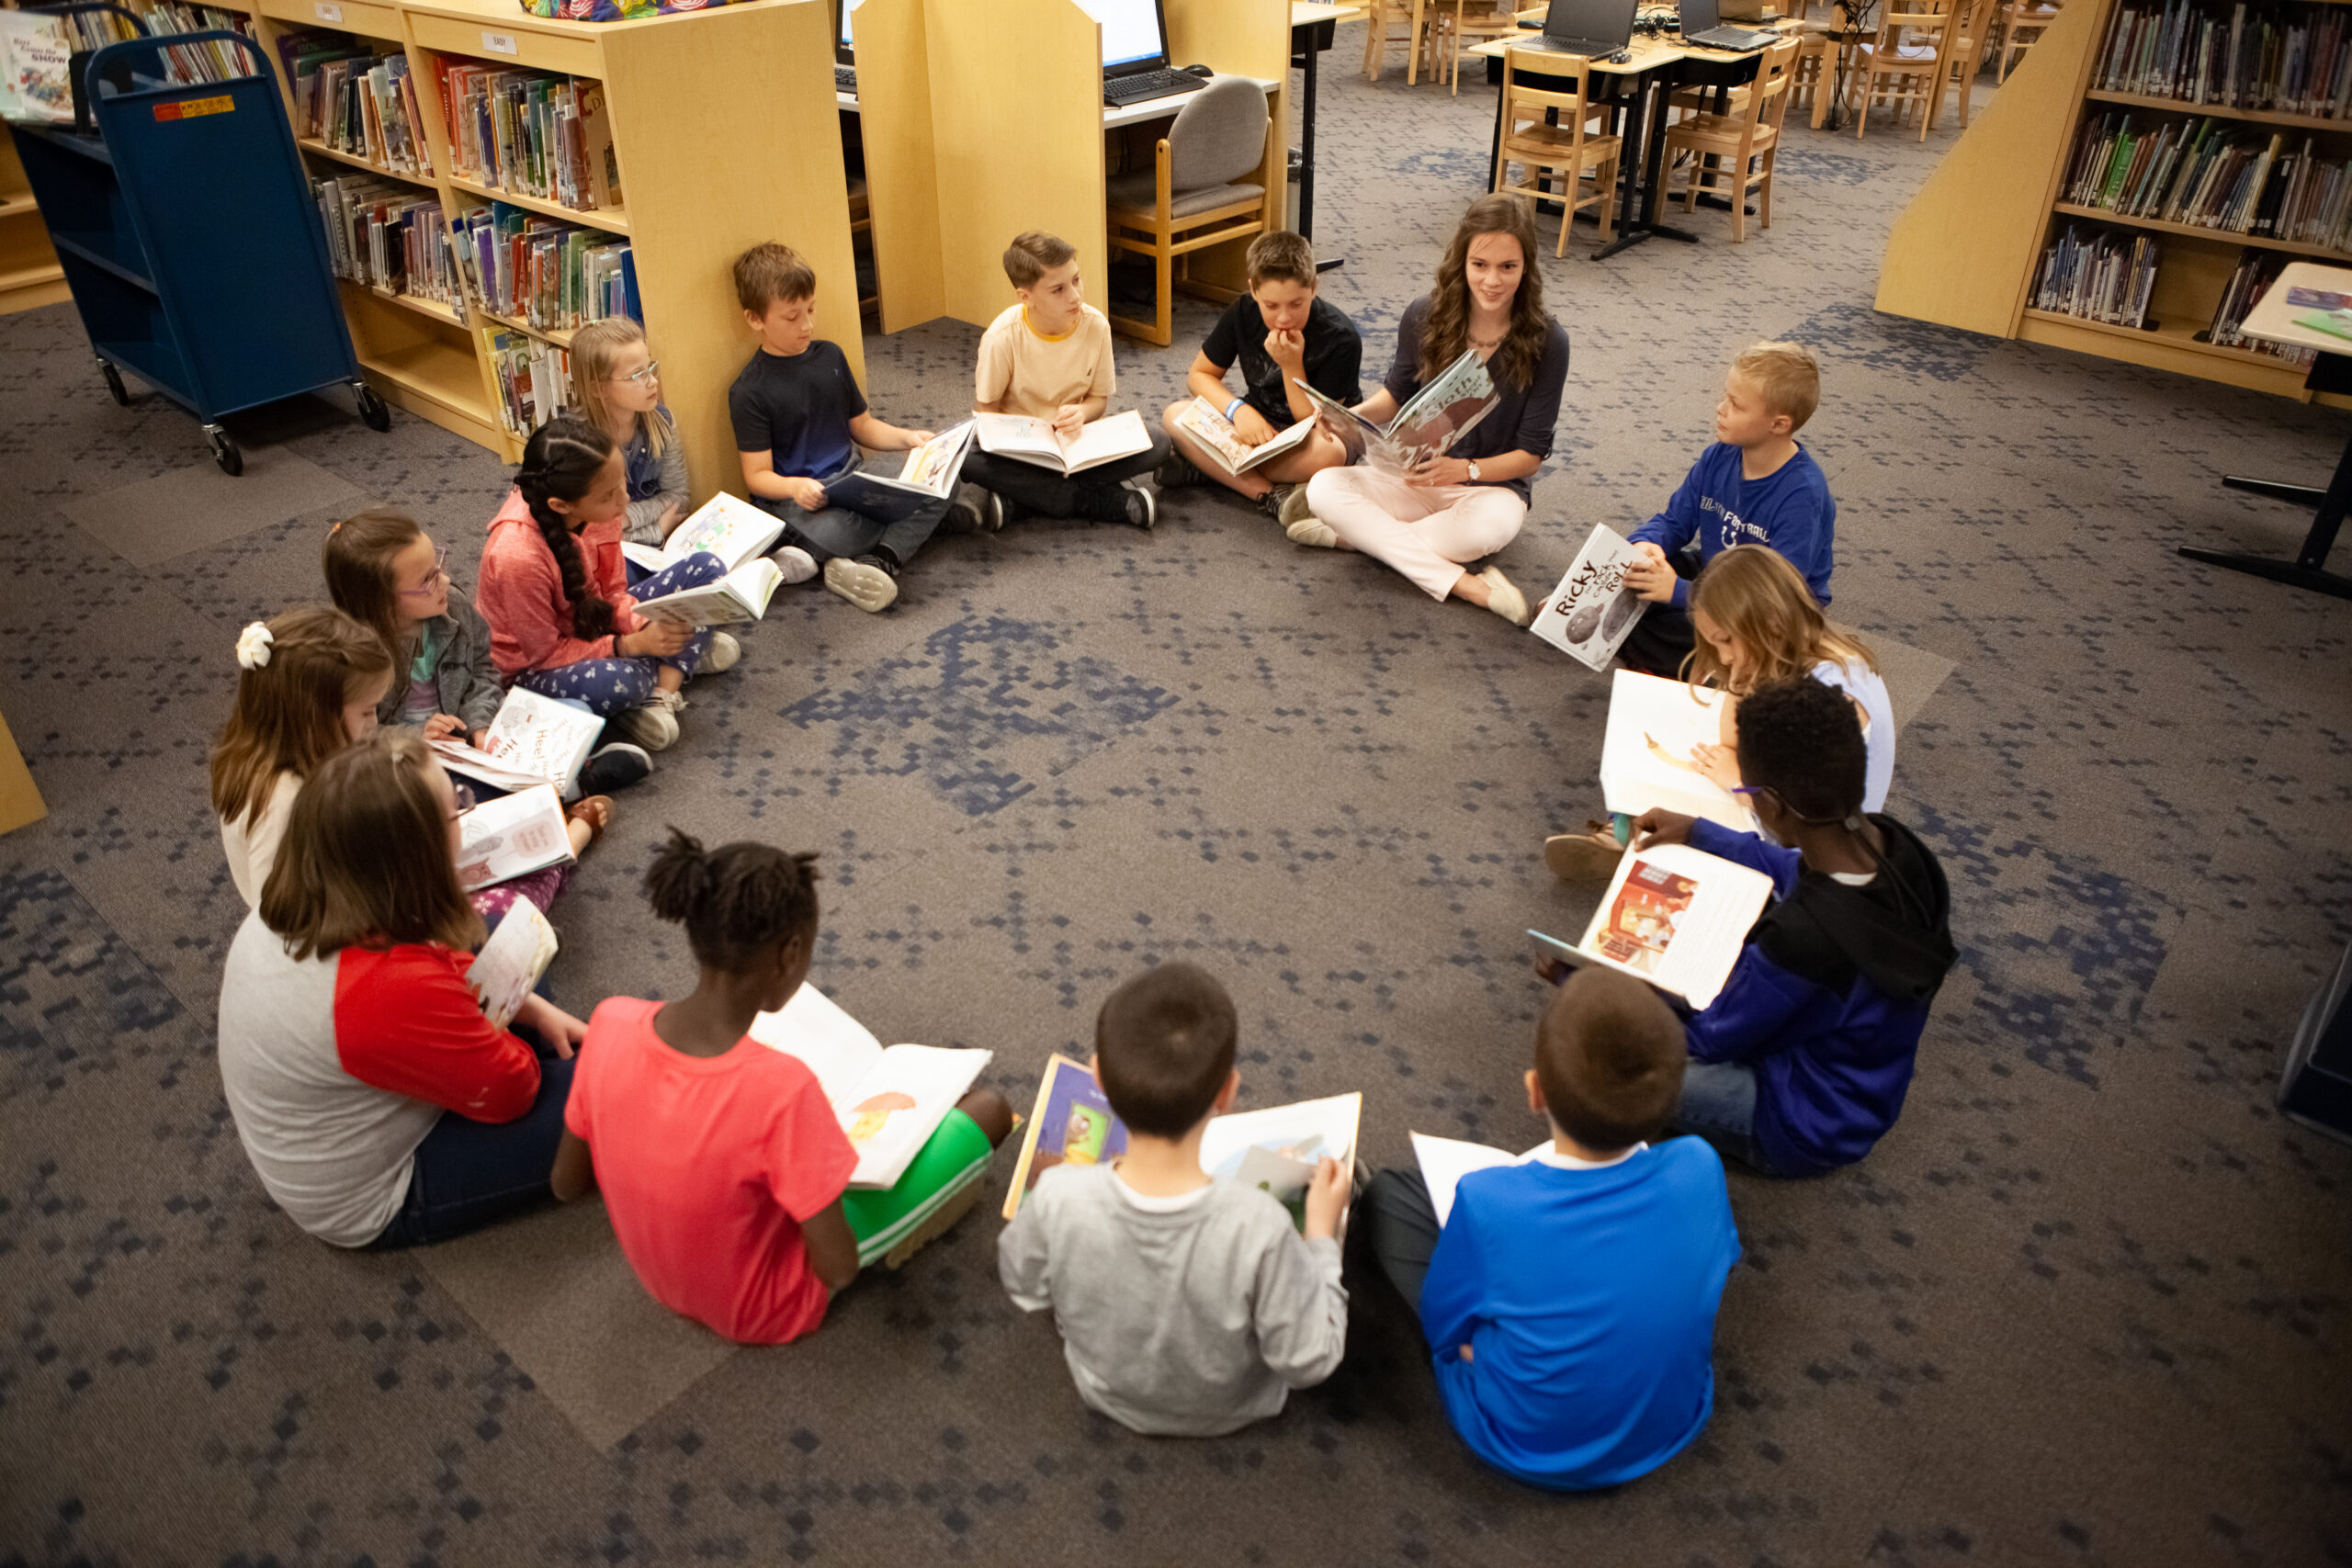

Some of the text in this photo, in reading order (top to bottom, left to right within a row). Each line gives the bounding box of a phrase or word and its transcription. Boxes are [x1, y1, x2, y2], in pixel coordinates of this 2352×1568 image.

[492, 36, 505, 46] EASY
[32, 53, 66, 64] SNOW
[1427, 377, 1472, 419] Sloth
[1723, 511, 1770, 543] FOOTBALL
[1555, 559, 1598, 617] Ricky
